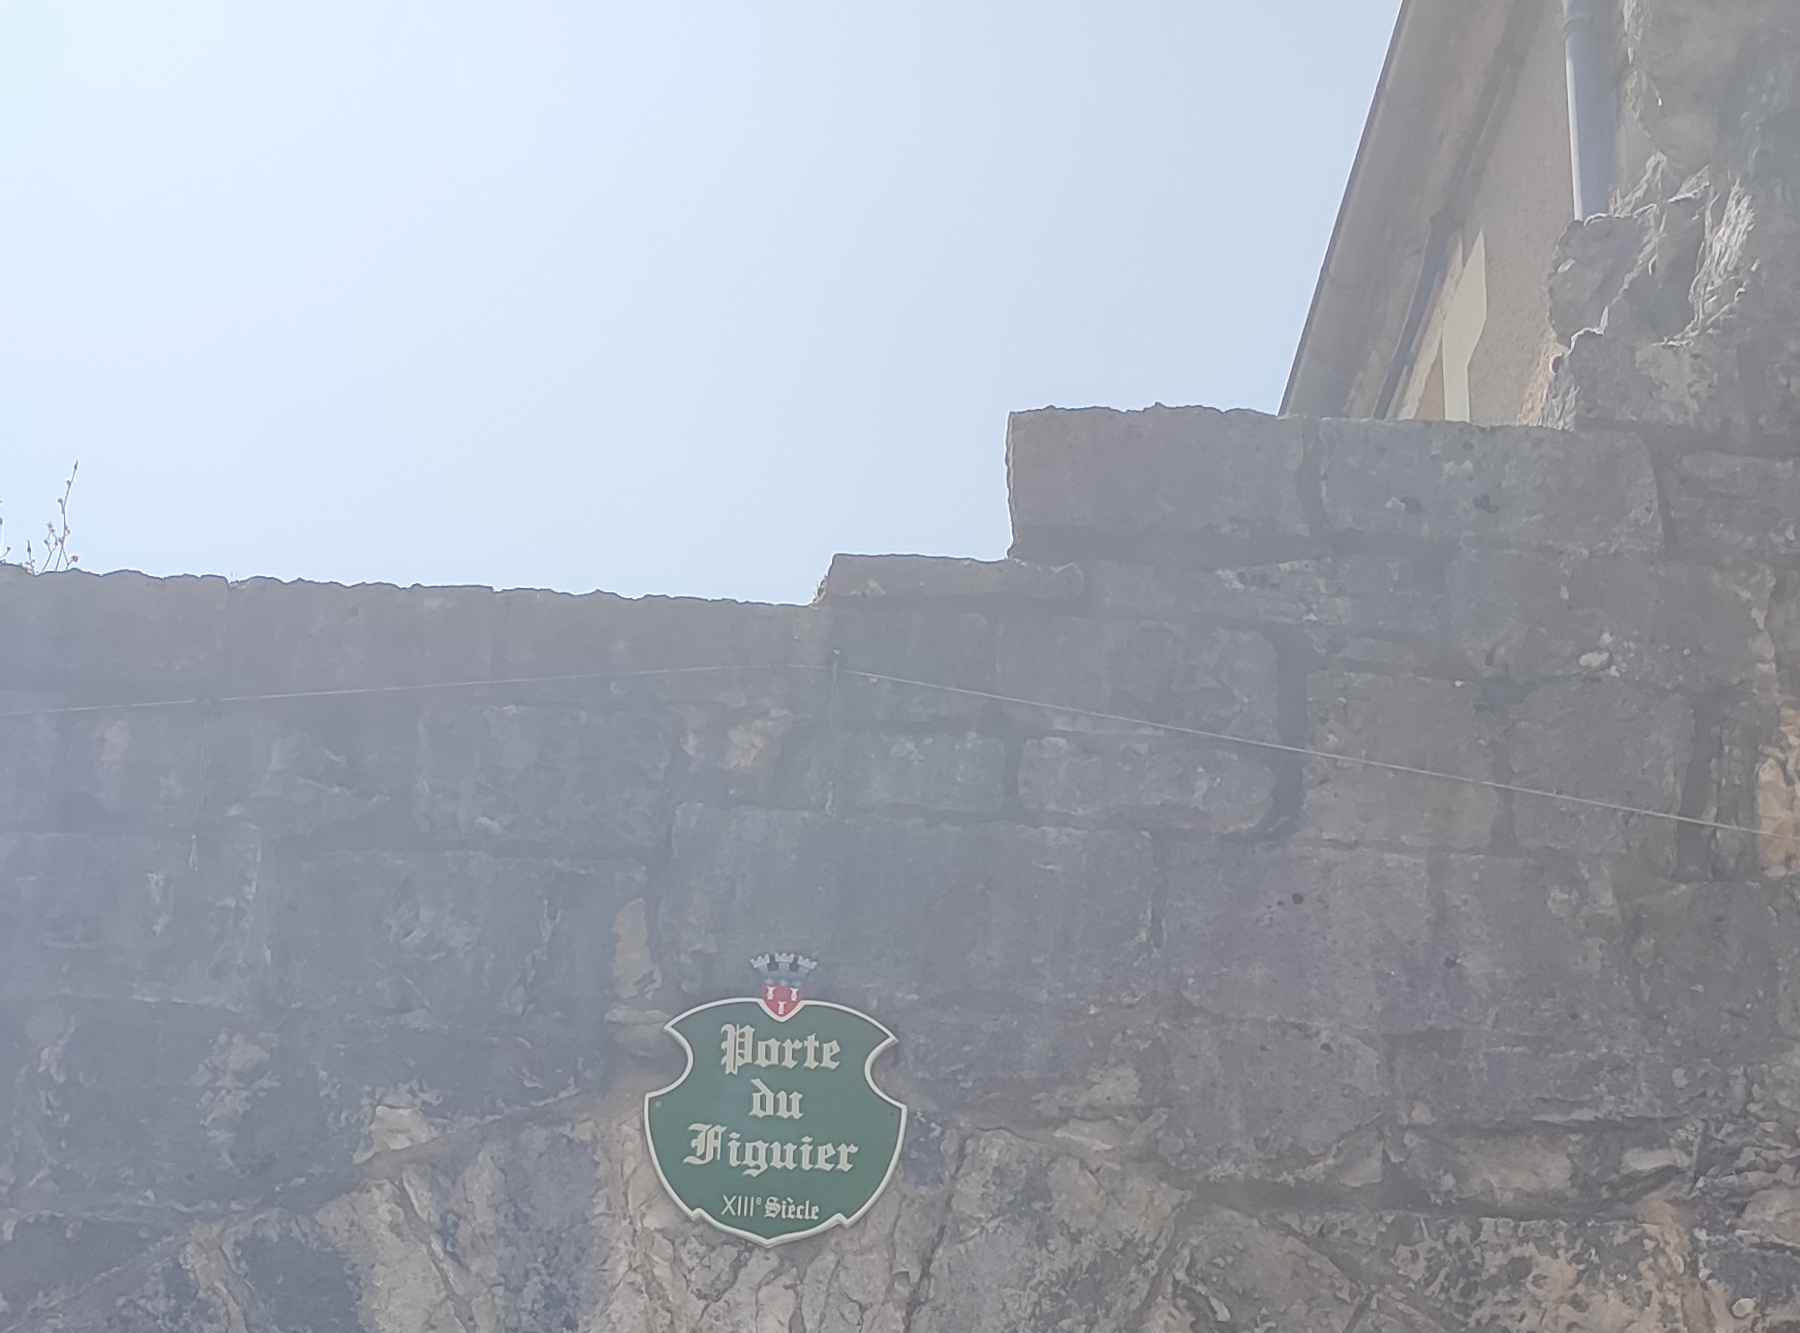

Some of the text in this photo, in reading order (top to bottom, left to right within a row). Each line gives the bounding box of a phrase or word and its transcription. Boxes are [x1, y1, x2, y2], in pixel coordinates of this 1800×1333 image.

[721, 1024, 841, 1075] Porte
[749, 1078, 803, 1119] du
[683, 1123, 858, 1177] Figuier
[764, 1196, 820, 1220] Siècle
